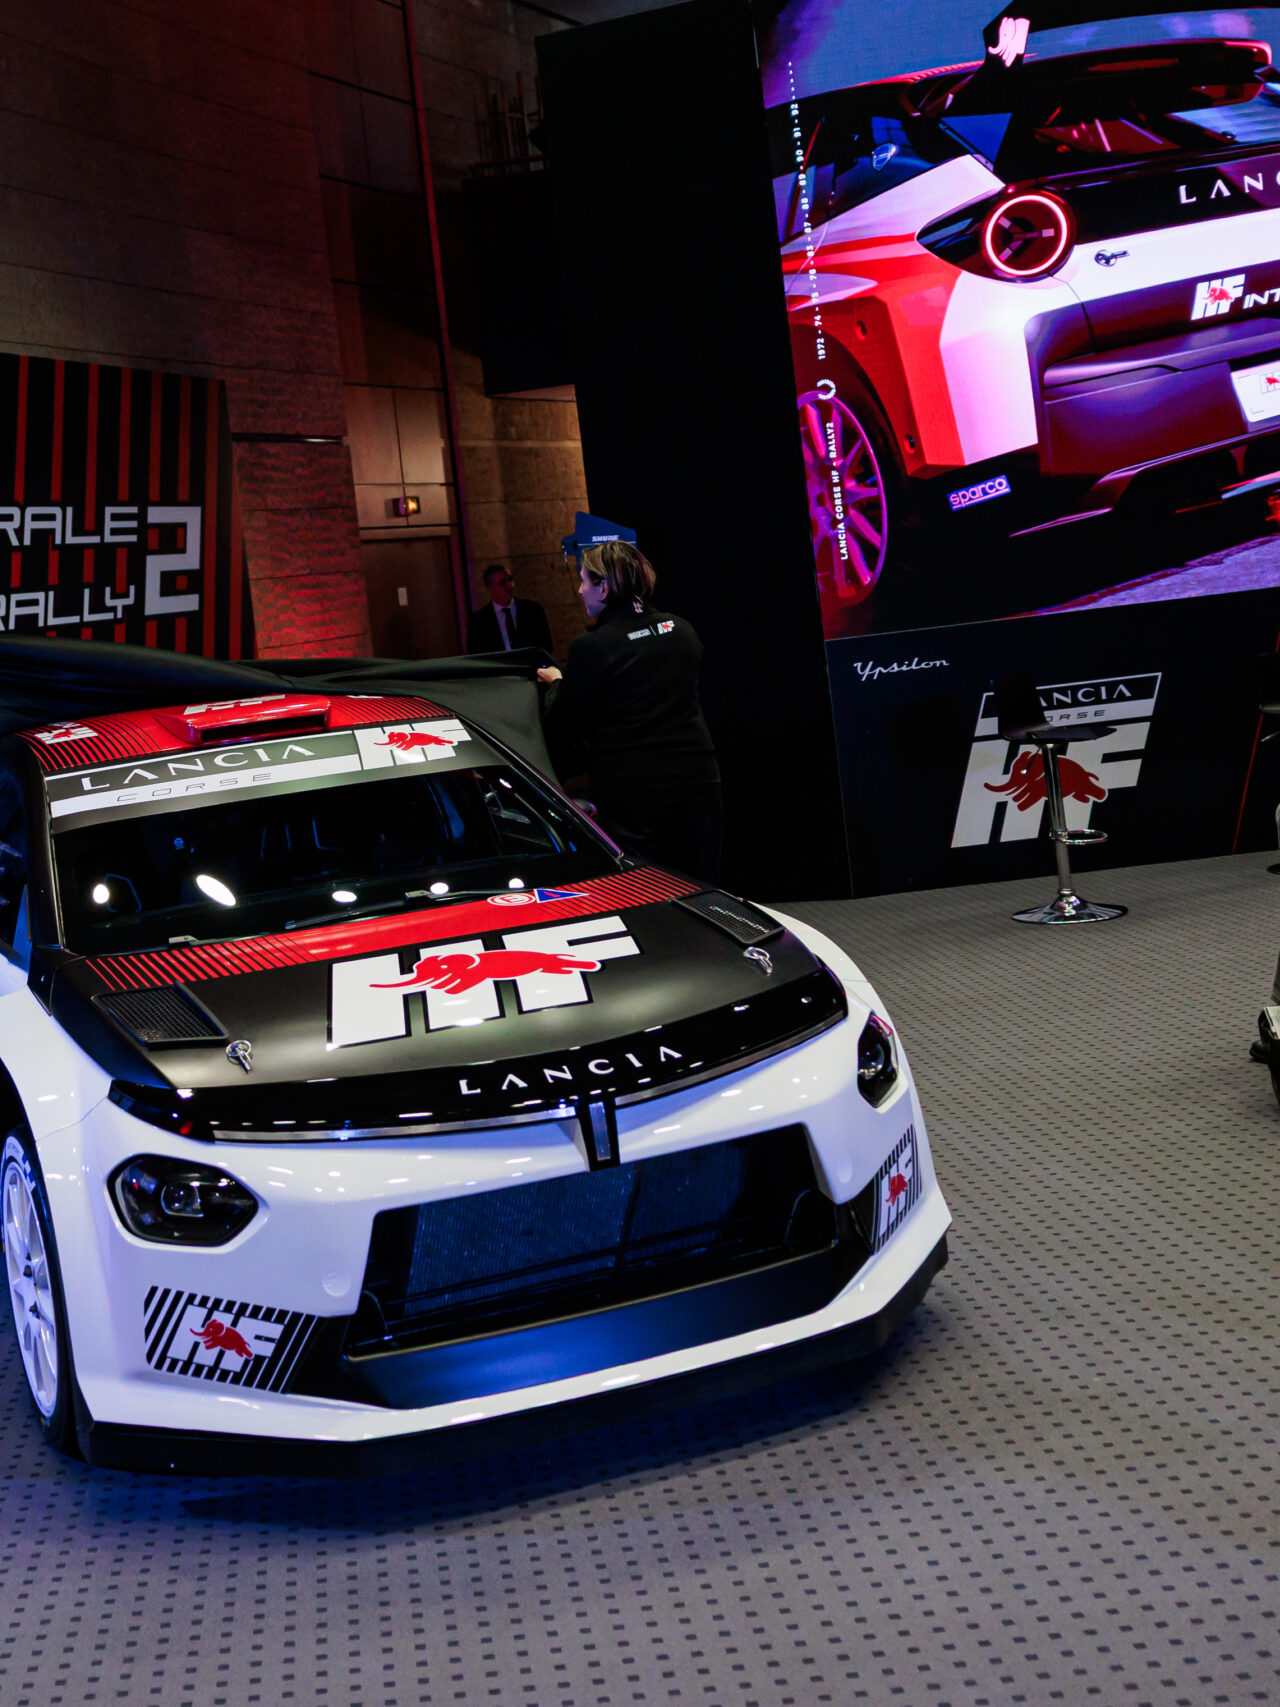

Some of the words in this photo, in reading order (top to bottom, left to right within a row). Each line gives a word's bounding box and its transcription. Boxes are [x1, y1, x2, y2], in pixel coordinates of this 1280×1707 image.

[790, 103, 799, 116] 92
[814, 314, 822, 327] 74
[816, 337, 826, 360] 1972
[826, 422, 837, 458] RALLY2
[831, 470, 840, 483] HF
[832, 486, 844, 519] CORSE
[949, 478, 1008, 508] sparco
[837, 522, 849, 560] LANCIA
[144, 506, 201, 616] 2
[853, 657, 950, 682] Ypsilon
[1040, 684, 1132, 707] NCIA
[1045, 709, 1106, 722] ORSE
[81, 744, 316, 791] LANCIA
[117, 772, 273, 803] CORSE
[459, 1046, 683, 1095] LANCIA
